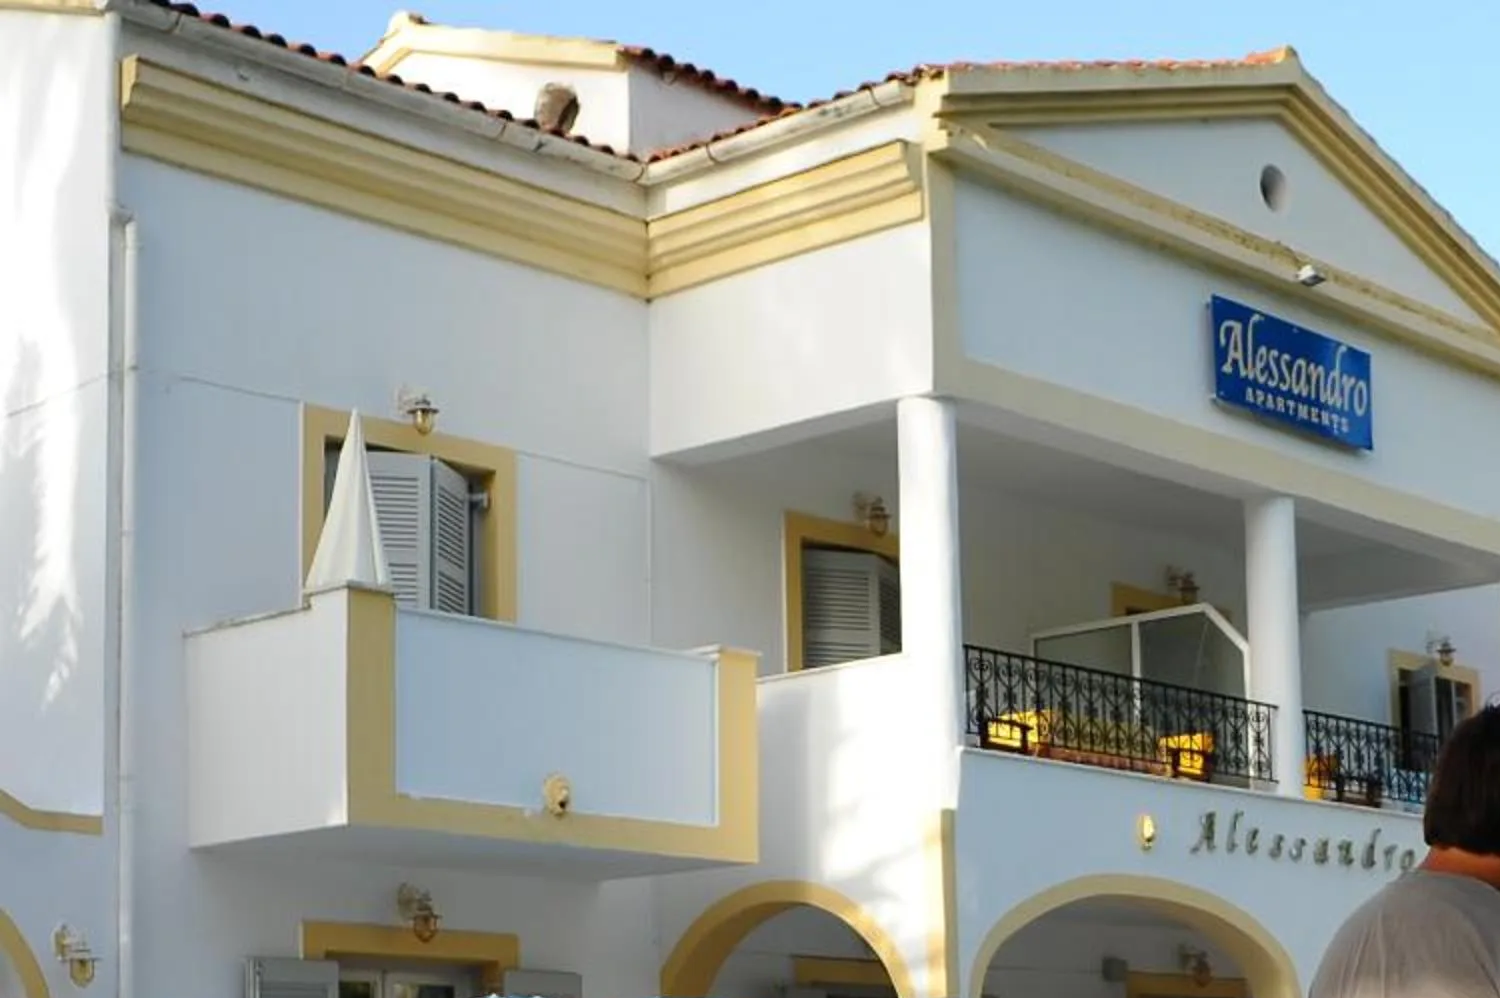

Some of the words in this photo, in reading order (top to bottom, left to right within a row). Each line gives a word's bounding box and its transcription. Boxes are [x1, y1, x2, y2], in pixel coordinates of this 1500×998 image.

[1219, 313, 1368, 416] Alessandro
[1245, 388, 1350, 434] APARTMENTS
[1190, 809, 1416, 871] Alessandro
